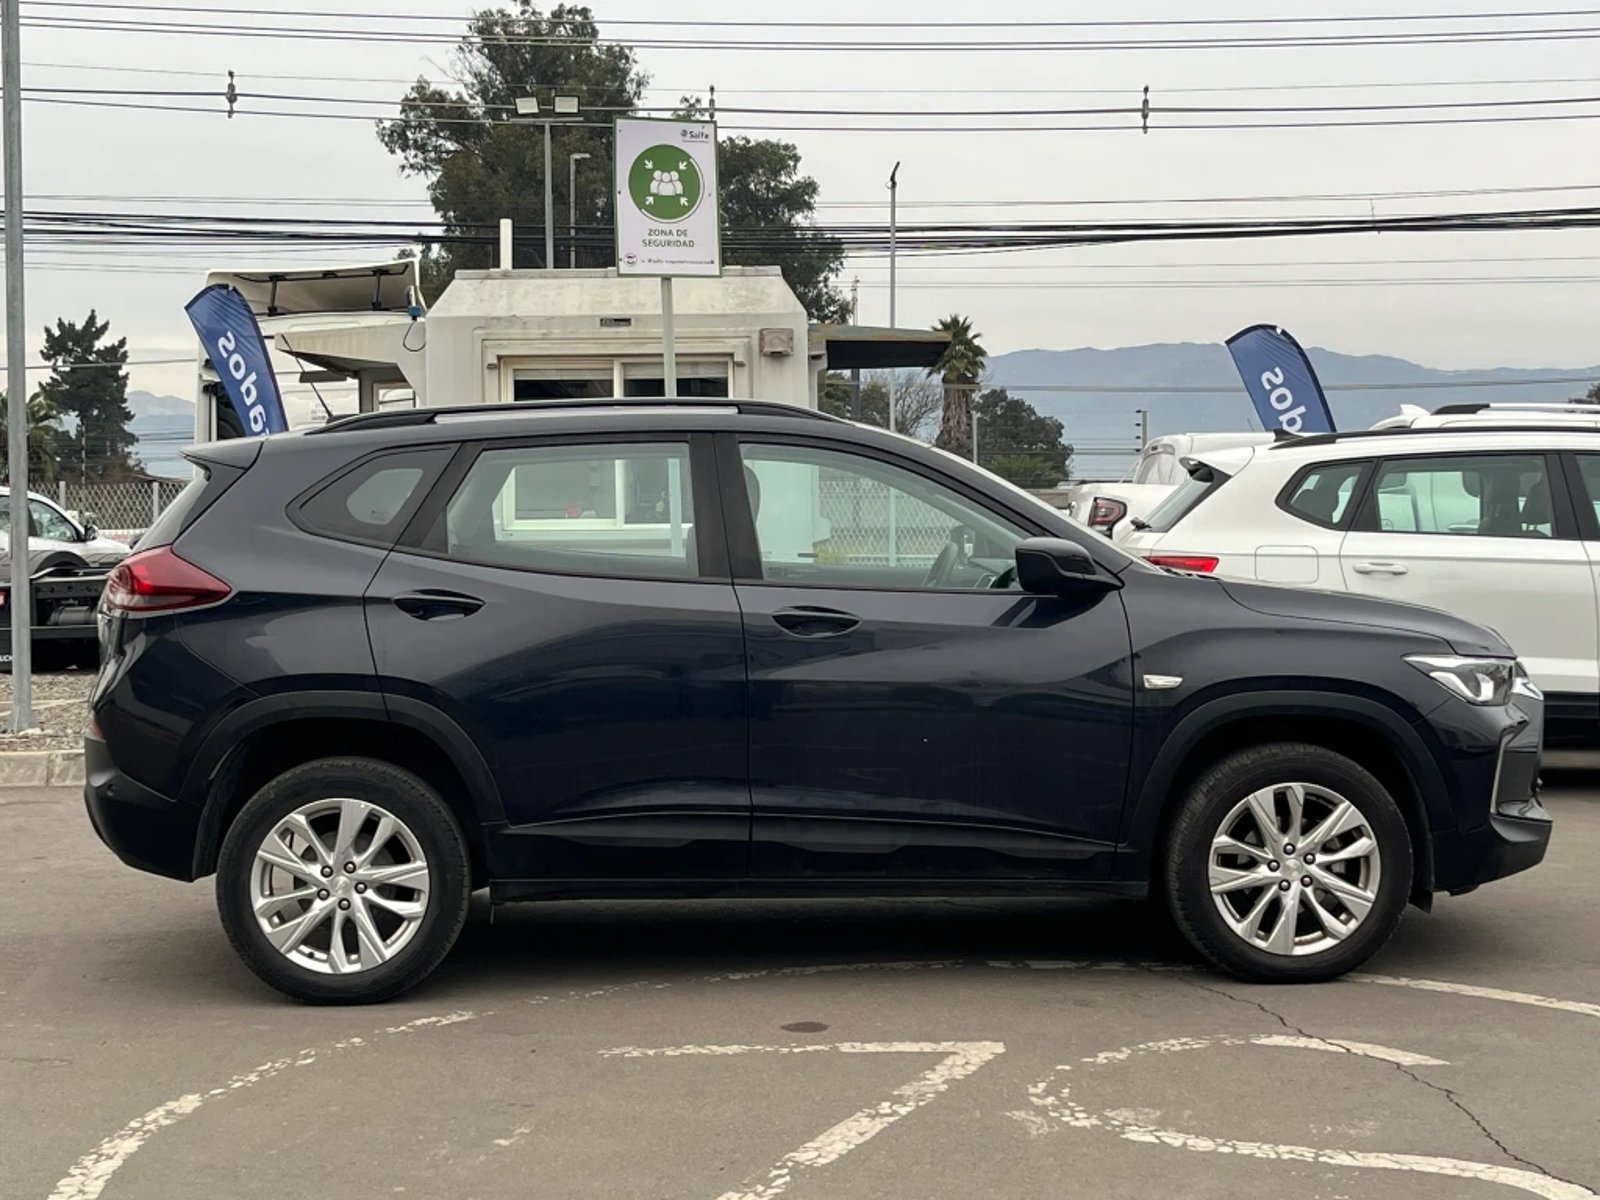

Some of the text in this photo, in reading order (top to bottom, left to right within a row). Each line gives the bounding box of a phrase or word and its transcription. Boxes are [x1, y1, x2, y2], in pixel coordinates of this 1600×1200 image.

[647, 227, 689, 237] ZONA DE
[641, 238, 695, 248] SEGURIDAD
